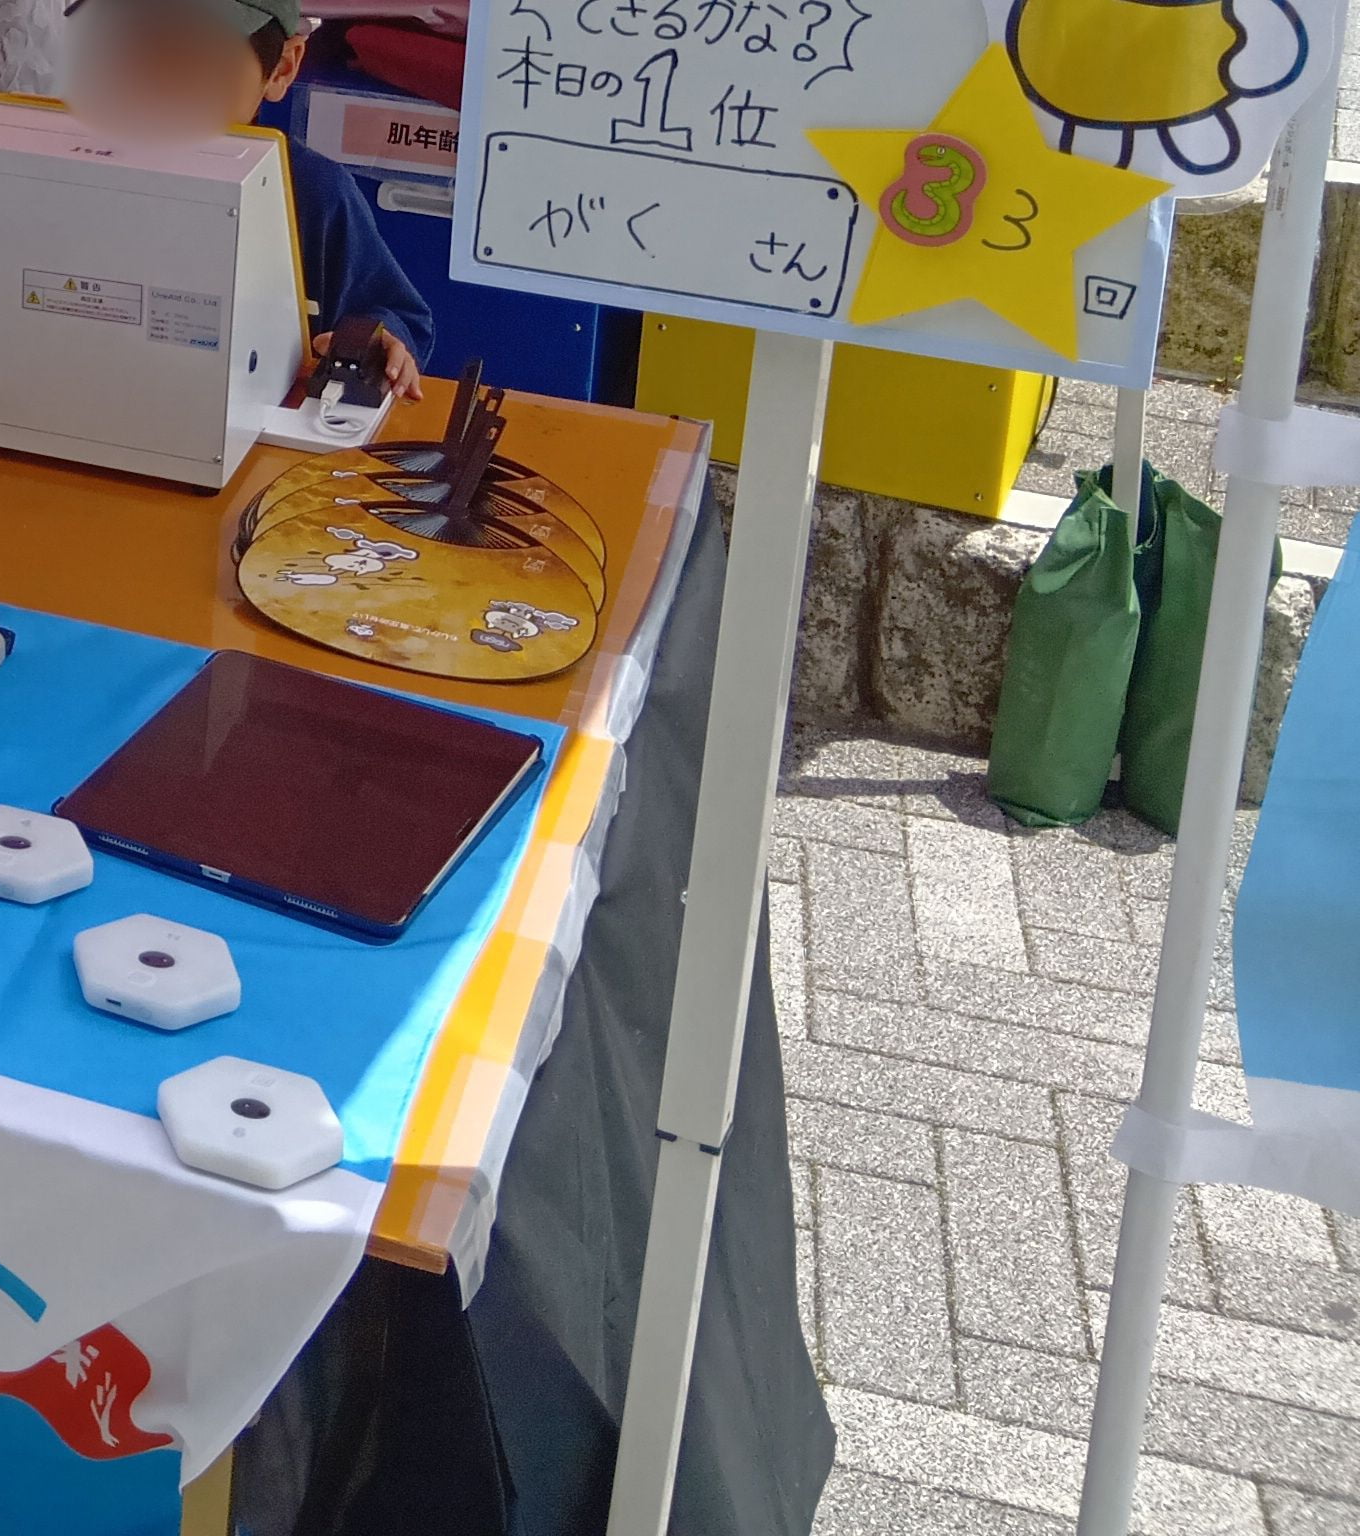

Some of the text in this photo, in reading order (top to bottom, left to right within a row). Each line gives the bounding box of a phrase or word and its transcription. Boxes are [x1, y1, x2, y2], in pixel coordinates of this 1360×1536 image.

[529, 194, 828, 282] がく さん
[1083, 275, 1137, 318] 回
